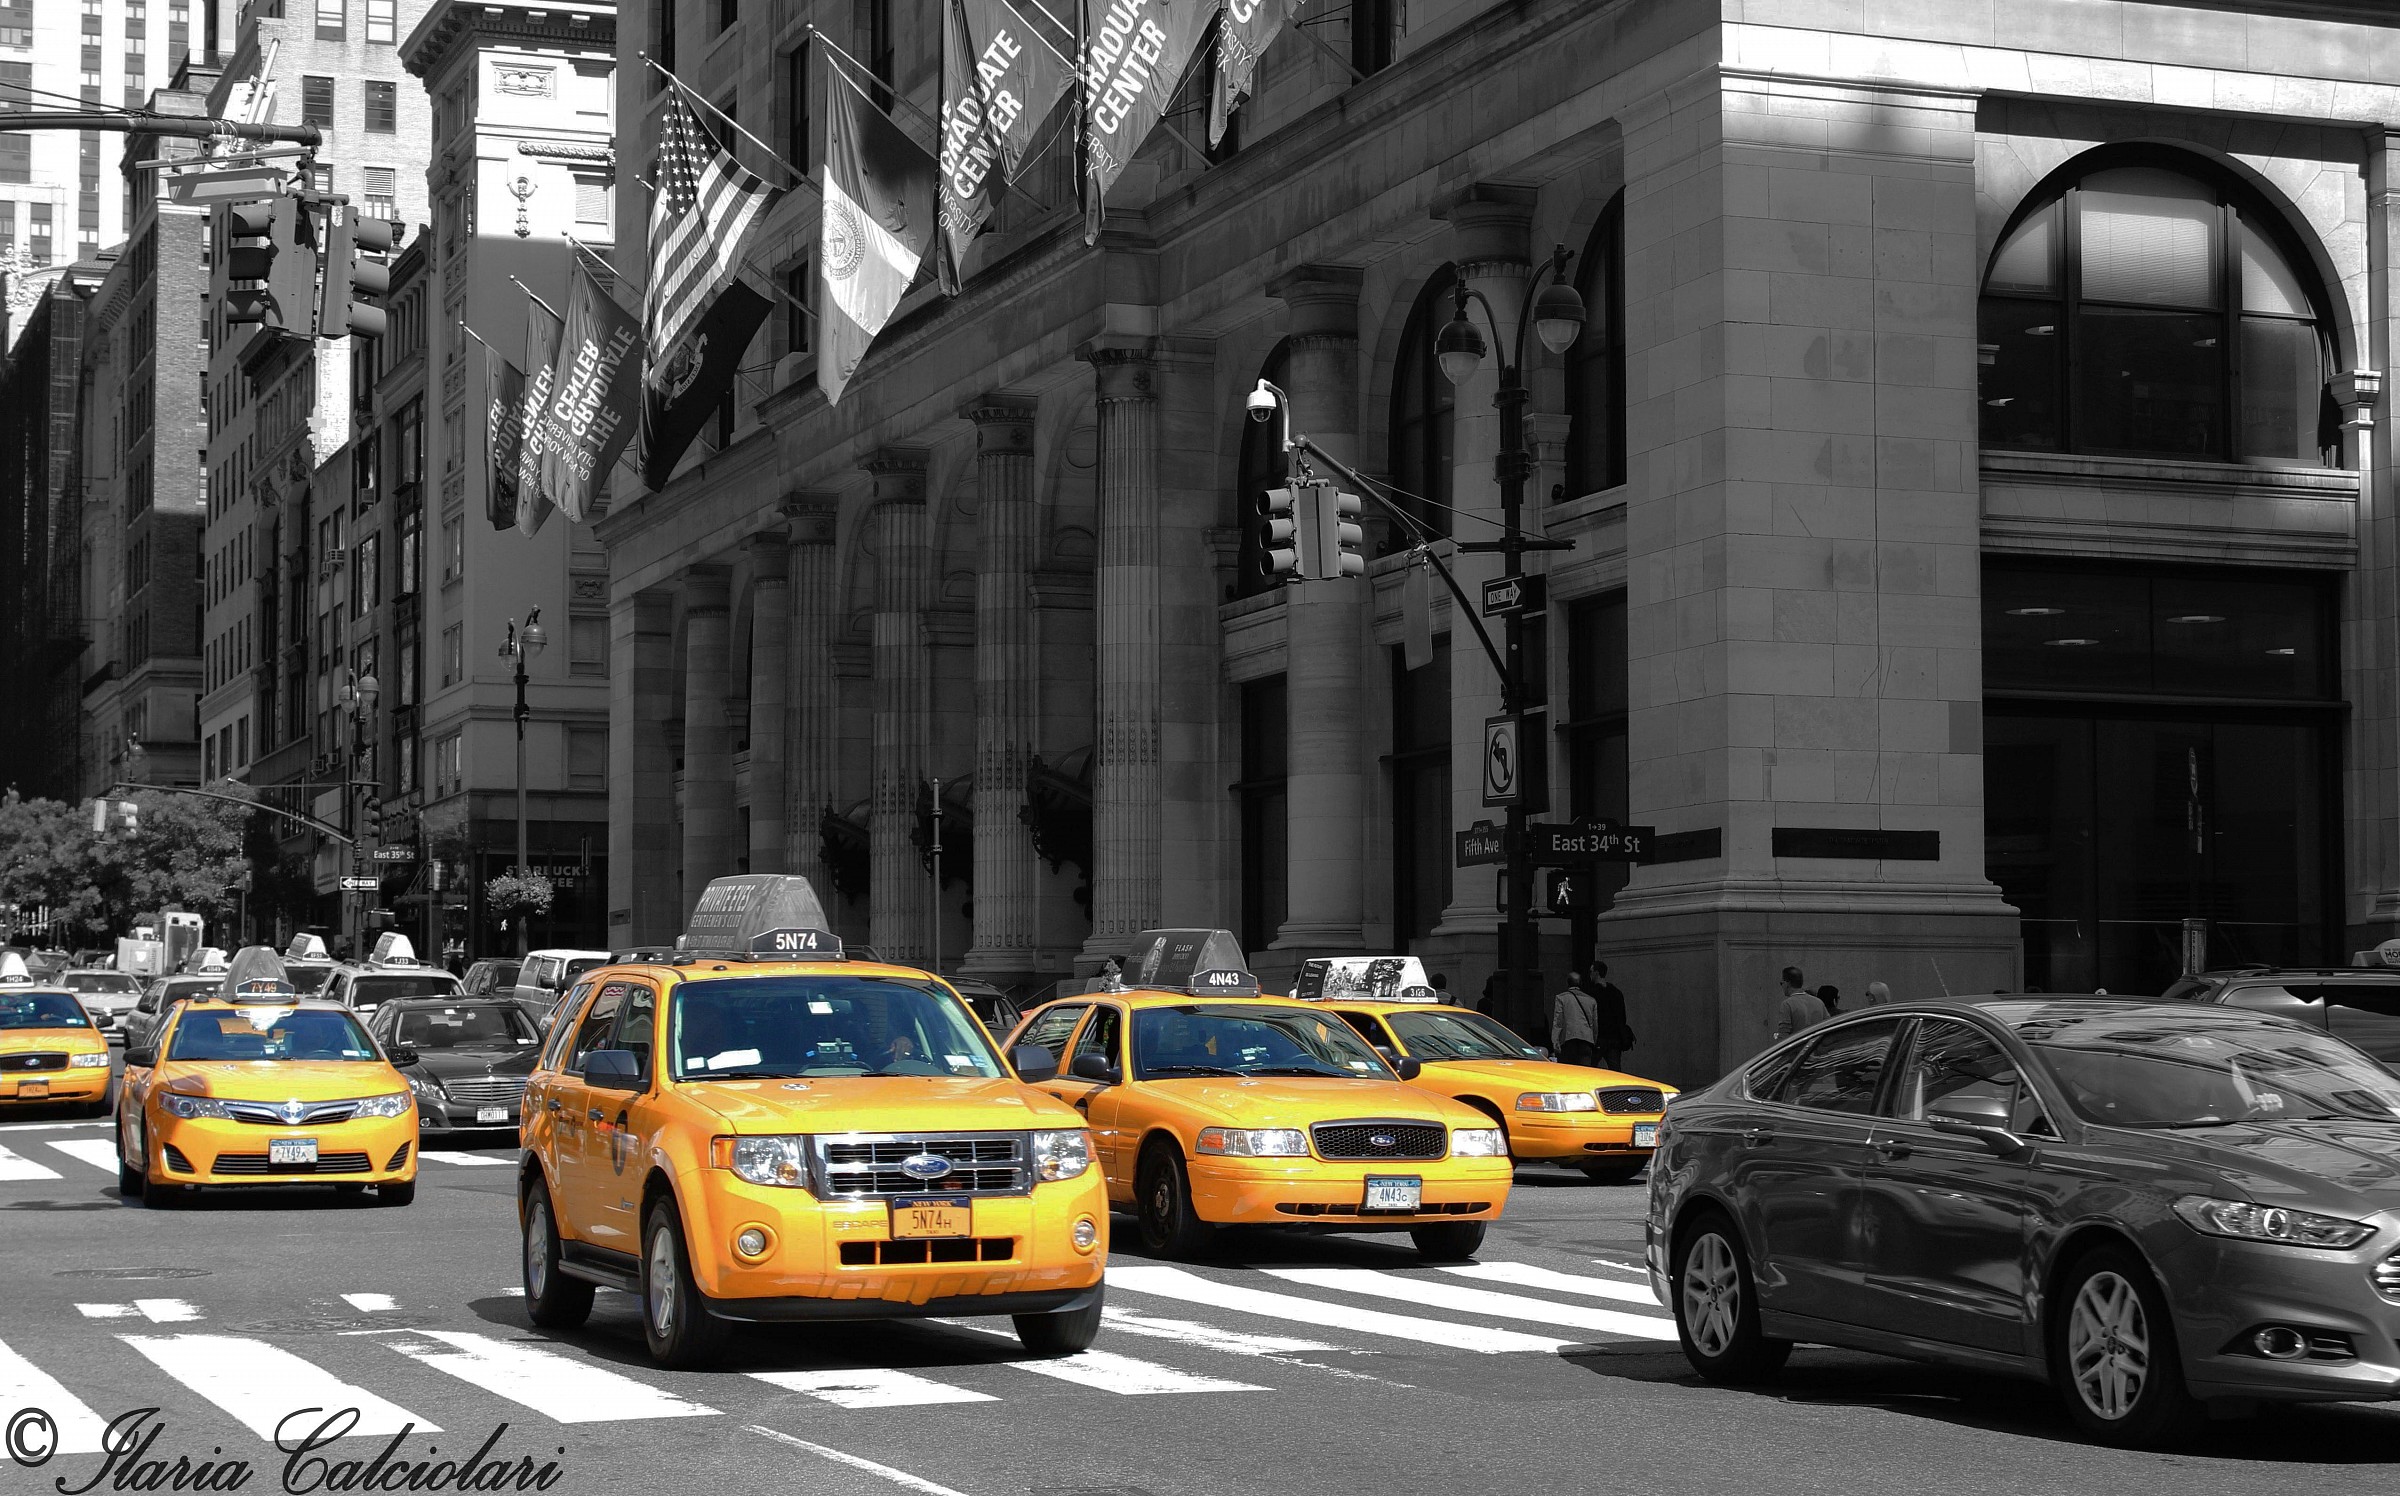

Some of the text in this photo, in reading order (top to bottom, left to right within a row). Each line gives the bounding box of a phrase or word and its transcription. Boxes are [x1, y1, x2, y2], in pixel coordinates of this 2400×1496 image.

[1094, 19, 1166, 135] CENTER
[940, 29, 1022, 177] GRADUATE
[1490, 586, 1518, 604] ONE WAY
[1464, 837, 1499, 857] Fifth Ave
[1552, 832, 1640, 853] East 34th St
[374, 849, 415, 860] East 35th St
[696, 885, 756, 912] PRIVATE EYES
[775, 932, 818, 950] 5N74
[1174, 944, 1194, 952] FLASH
[251, 982, 277, 993] 7Y49
[1209, 972, 1239, 985] 4N43
[832, 1220, 888, 1229] ESCAPE
